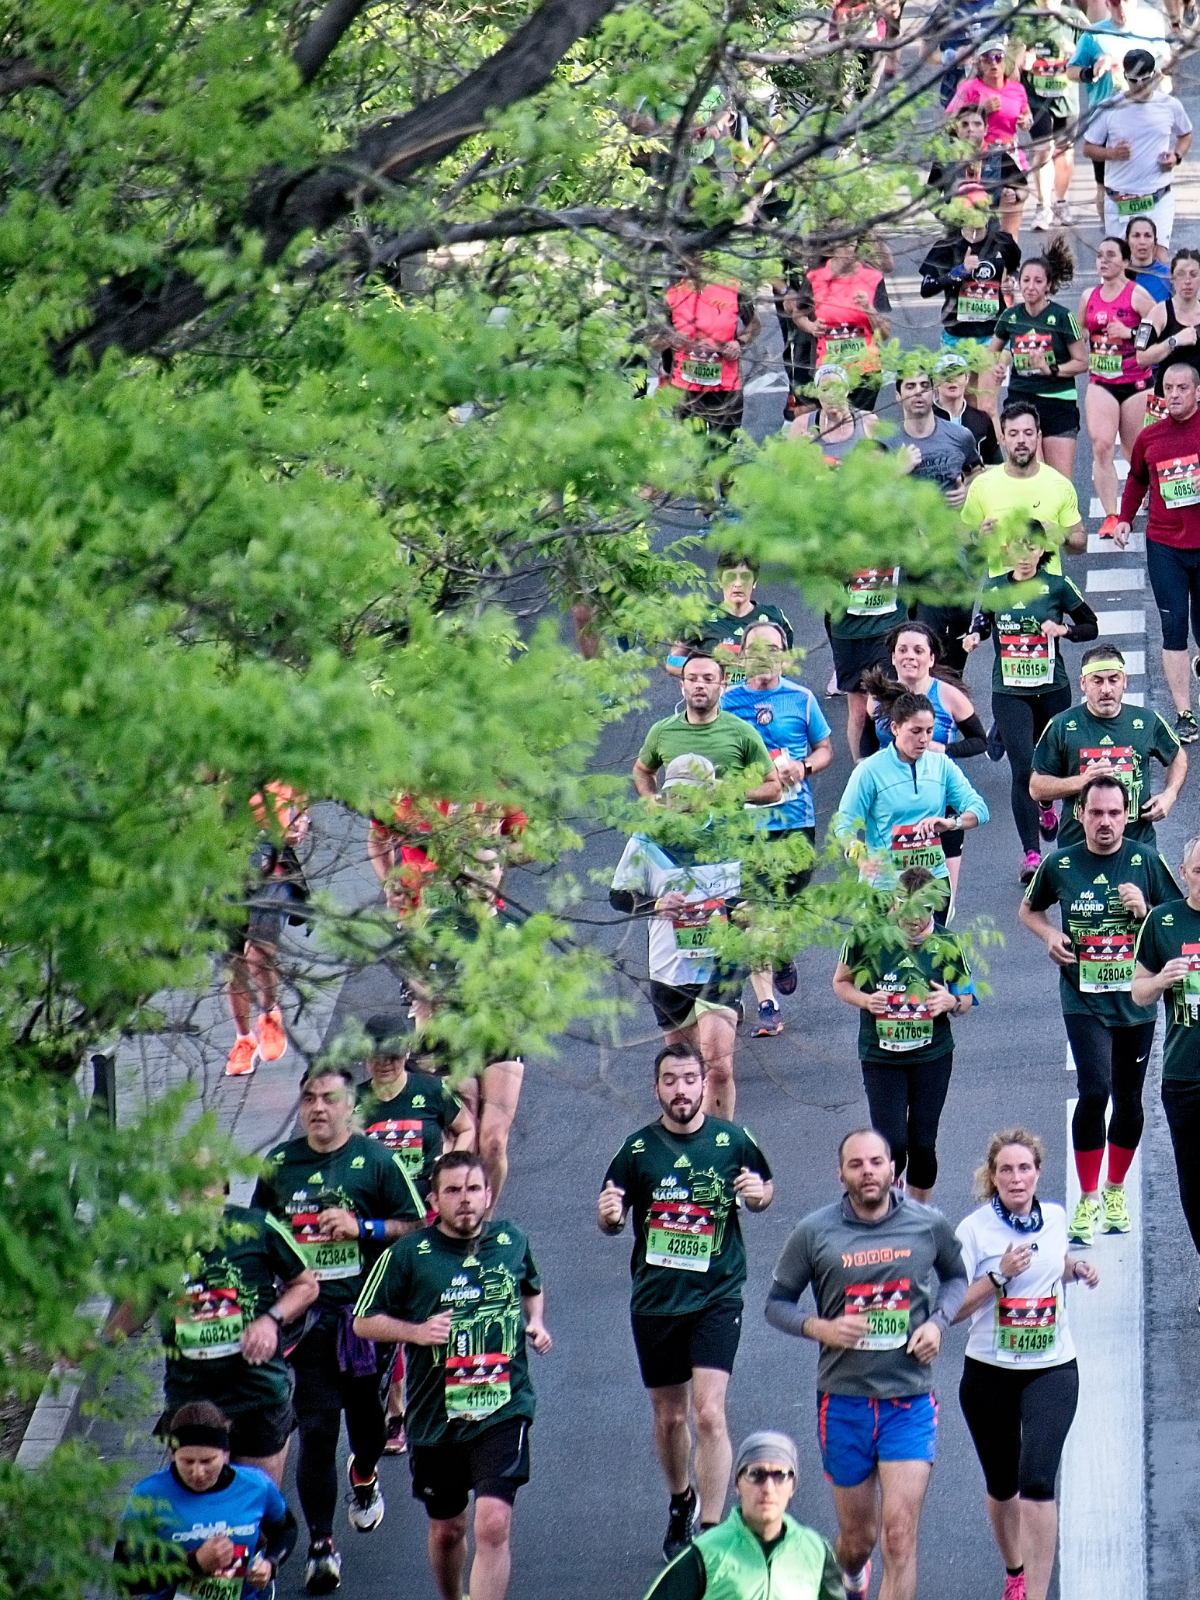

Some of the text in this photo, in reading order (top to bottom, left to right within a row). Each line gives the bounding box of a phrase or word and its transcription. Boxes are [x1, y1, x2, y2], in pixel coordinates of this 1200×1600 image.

[1010, 663, 1040, 676] F41915
[1080, 890, 1094, 900] edp
[1070, 903, 1104, 913] MADRID
[1097, 968, 1125, 981] 42804
[876, 983, 907, 994] MADRID
[887, 1026, 922, 1040] F41760
[661, 1175, 678, 1188] edp
[652, 1190, 690, 1201] MADRID
[667, 1238, 699, 1257] 42859
[315, 1250, 348, 1267] 42384
[451, 1275, 468, 1288] edp
[440, 1289, 481, 1303] MADRID
[198, 1329, 232, 1344] 40821
[1010, 1334, 1048, 1351] F41439
[465, 1388, 500, 1406] 41500
